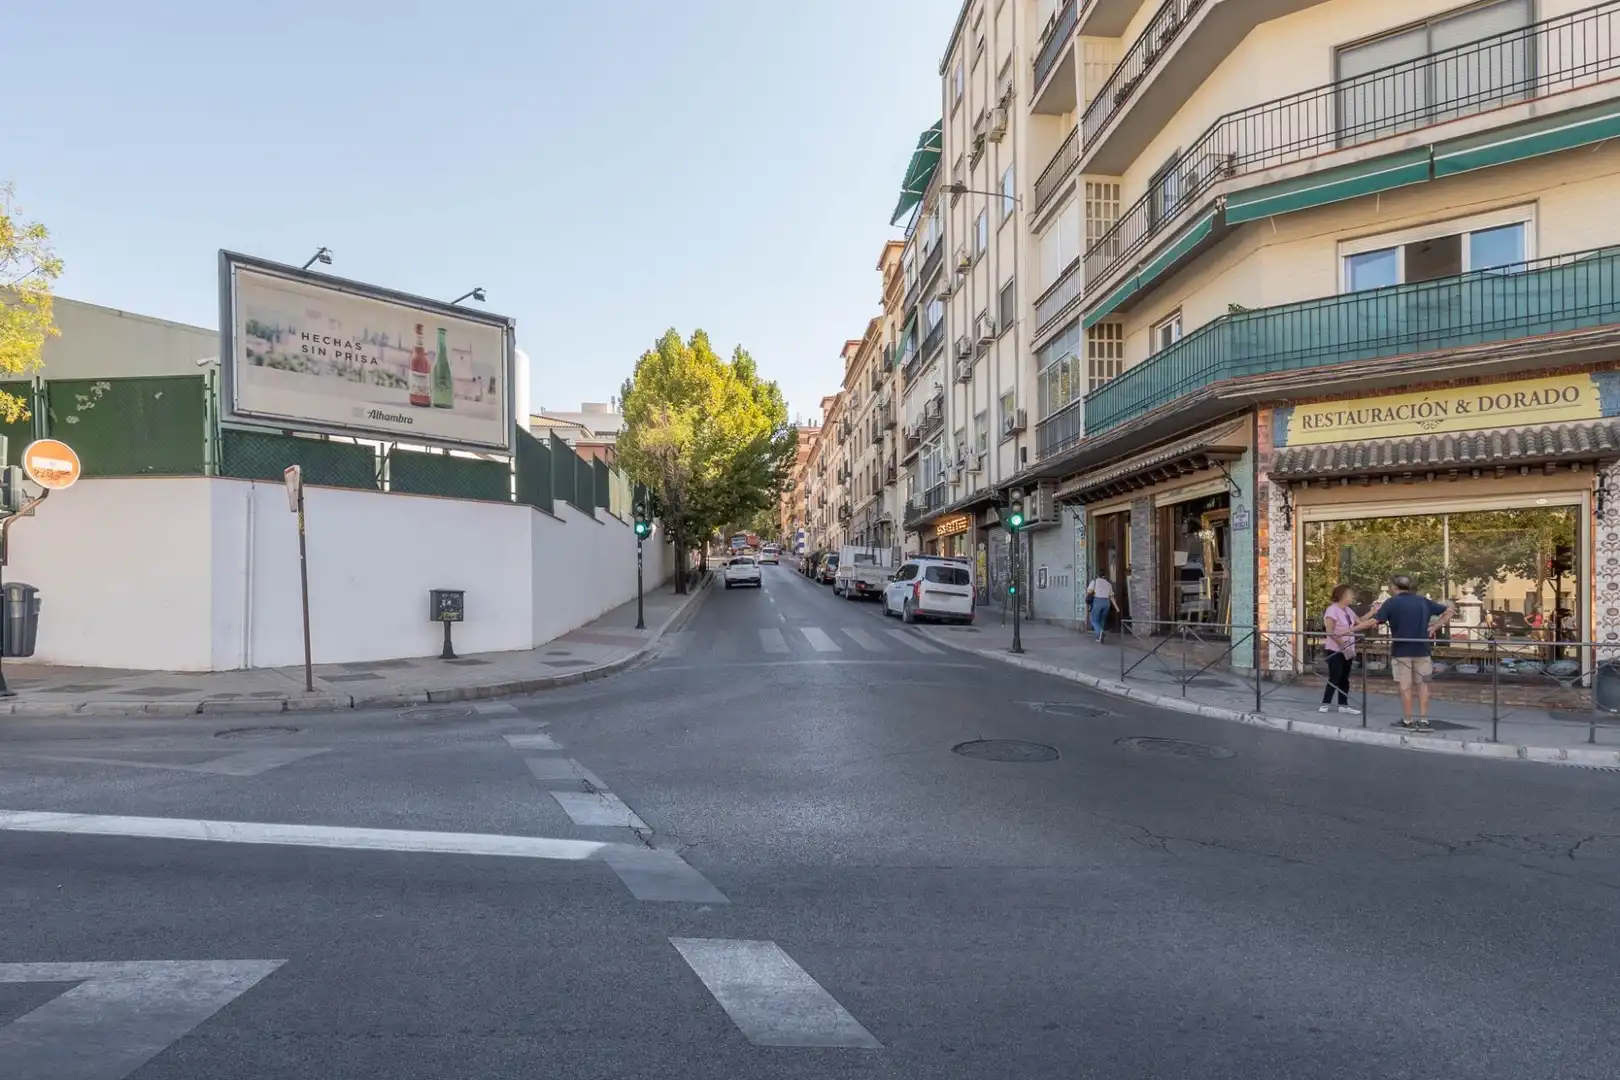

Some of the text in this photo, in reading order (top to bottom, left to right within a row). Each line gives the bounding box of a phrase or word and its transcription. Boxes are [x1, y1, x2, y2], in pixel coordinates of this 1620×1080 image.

[301, 332, 362, 350] HECHAS
[301, 344, 378, 365] SIN PRISA
[366, 409, 414, 424] Alhambra
[1302, 385, 1580, 430] RESTAURACIÓN & DORADO
